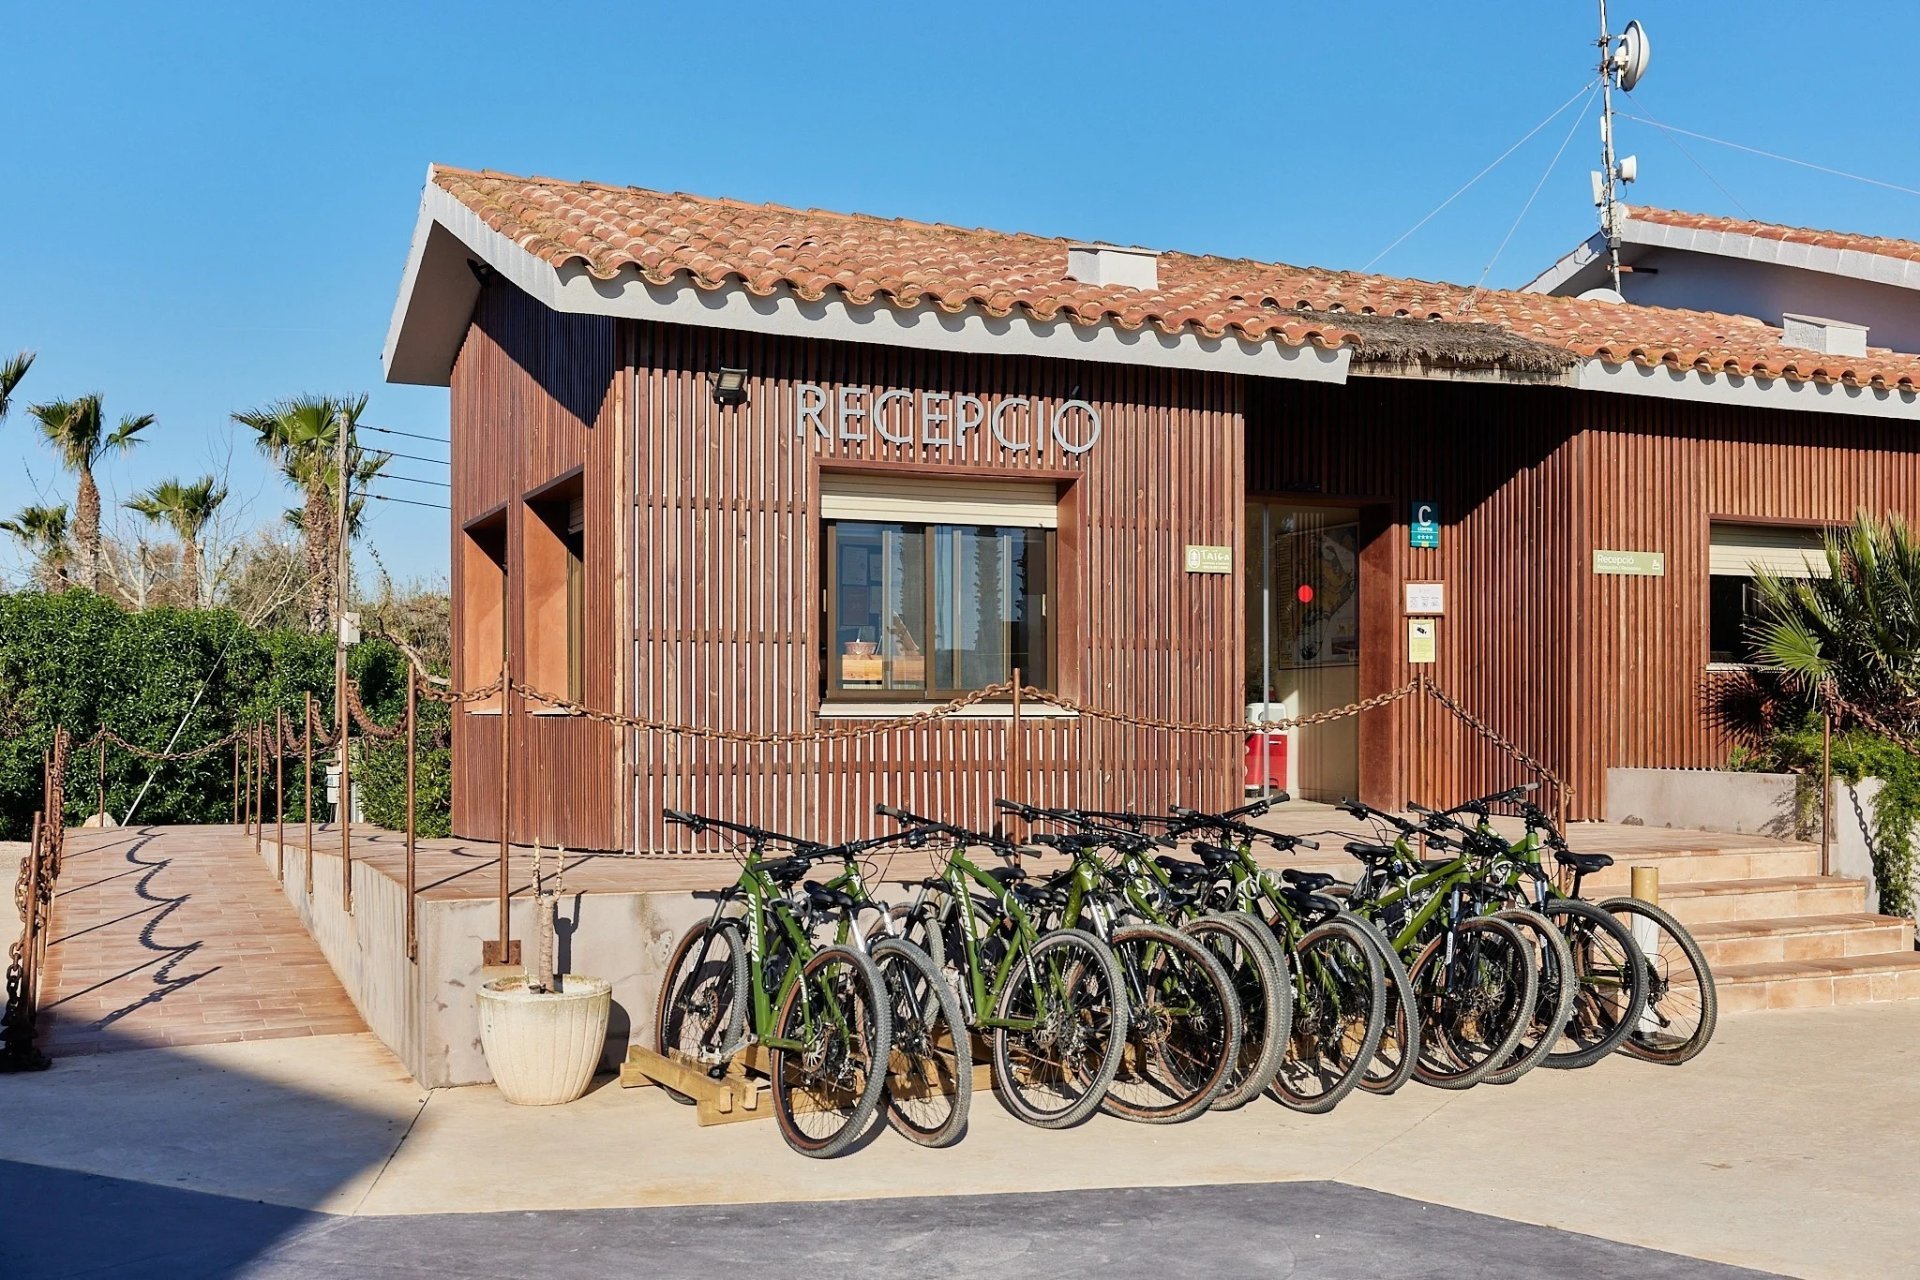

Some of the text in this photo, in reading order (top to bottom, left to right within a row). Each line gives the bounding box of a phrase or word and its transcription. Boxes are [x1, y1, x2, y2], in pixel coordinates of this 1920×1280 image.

[1418, 505, 1432, 527] C
[747, 893, 760, 962] VITORIA
[955, 881, 974, 942] VITORIA
